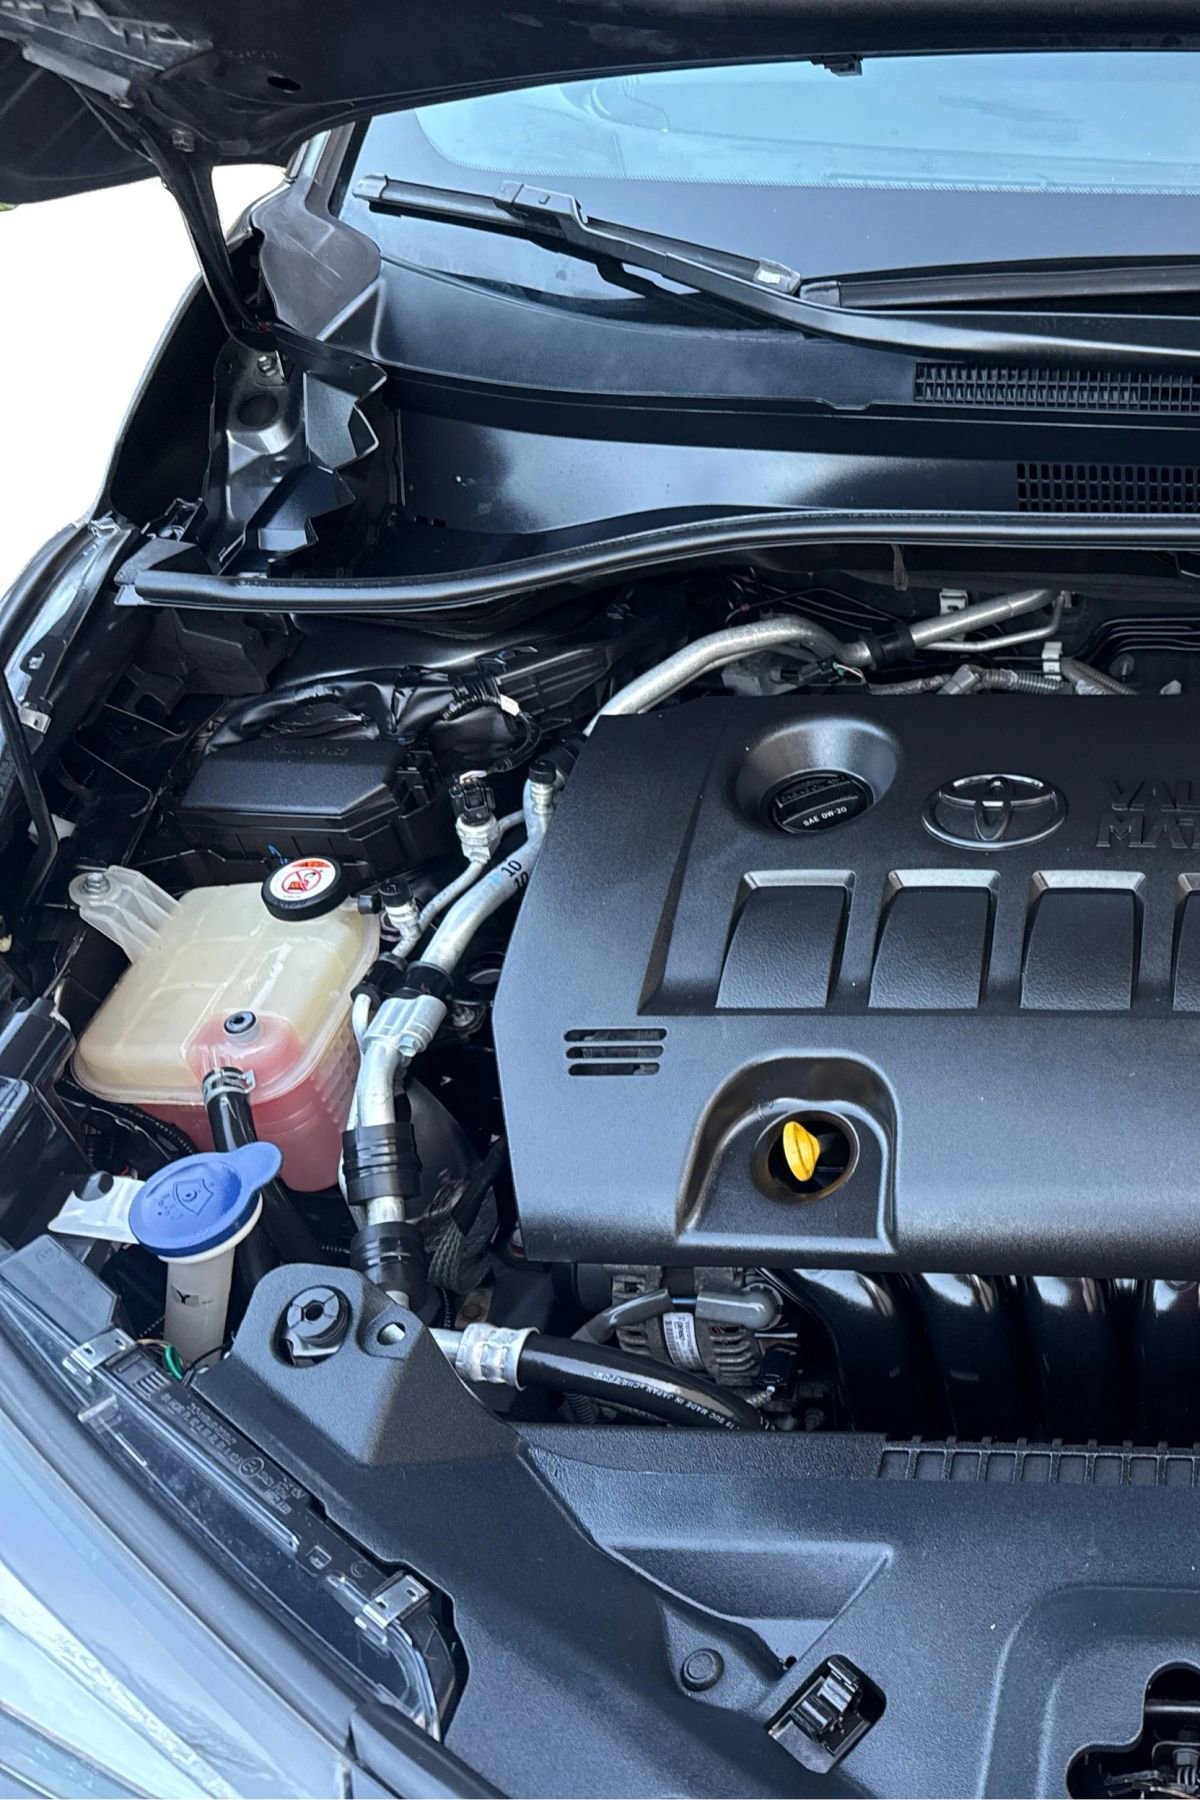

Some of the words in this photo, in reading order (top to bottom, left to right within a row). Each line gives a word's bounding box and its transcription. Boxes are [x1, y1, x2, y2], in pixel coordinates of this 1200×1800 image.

[802, 816, 820, 827] SAE
[821, 806, 848, 821] 0W-20
[501, 860, 522, 878] 10
[645, 1385, 674, 1401] JAPAN
[674, 1396, 686, 1407] IN
[685, 1400, 708, 1416] MADE
